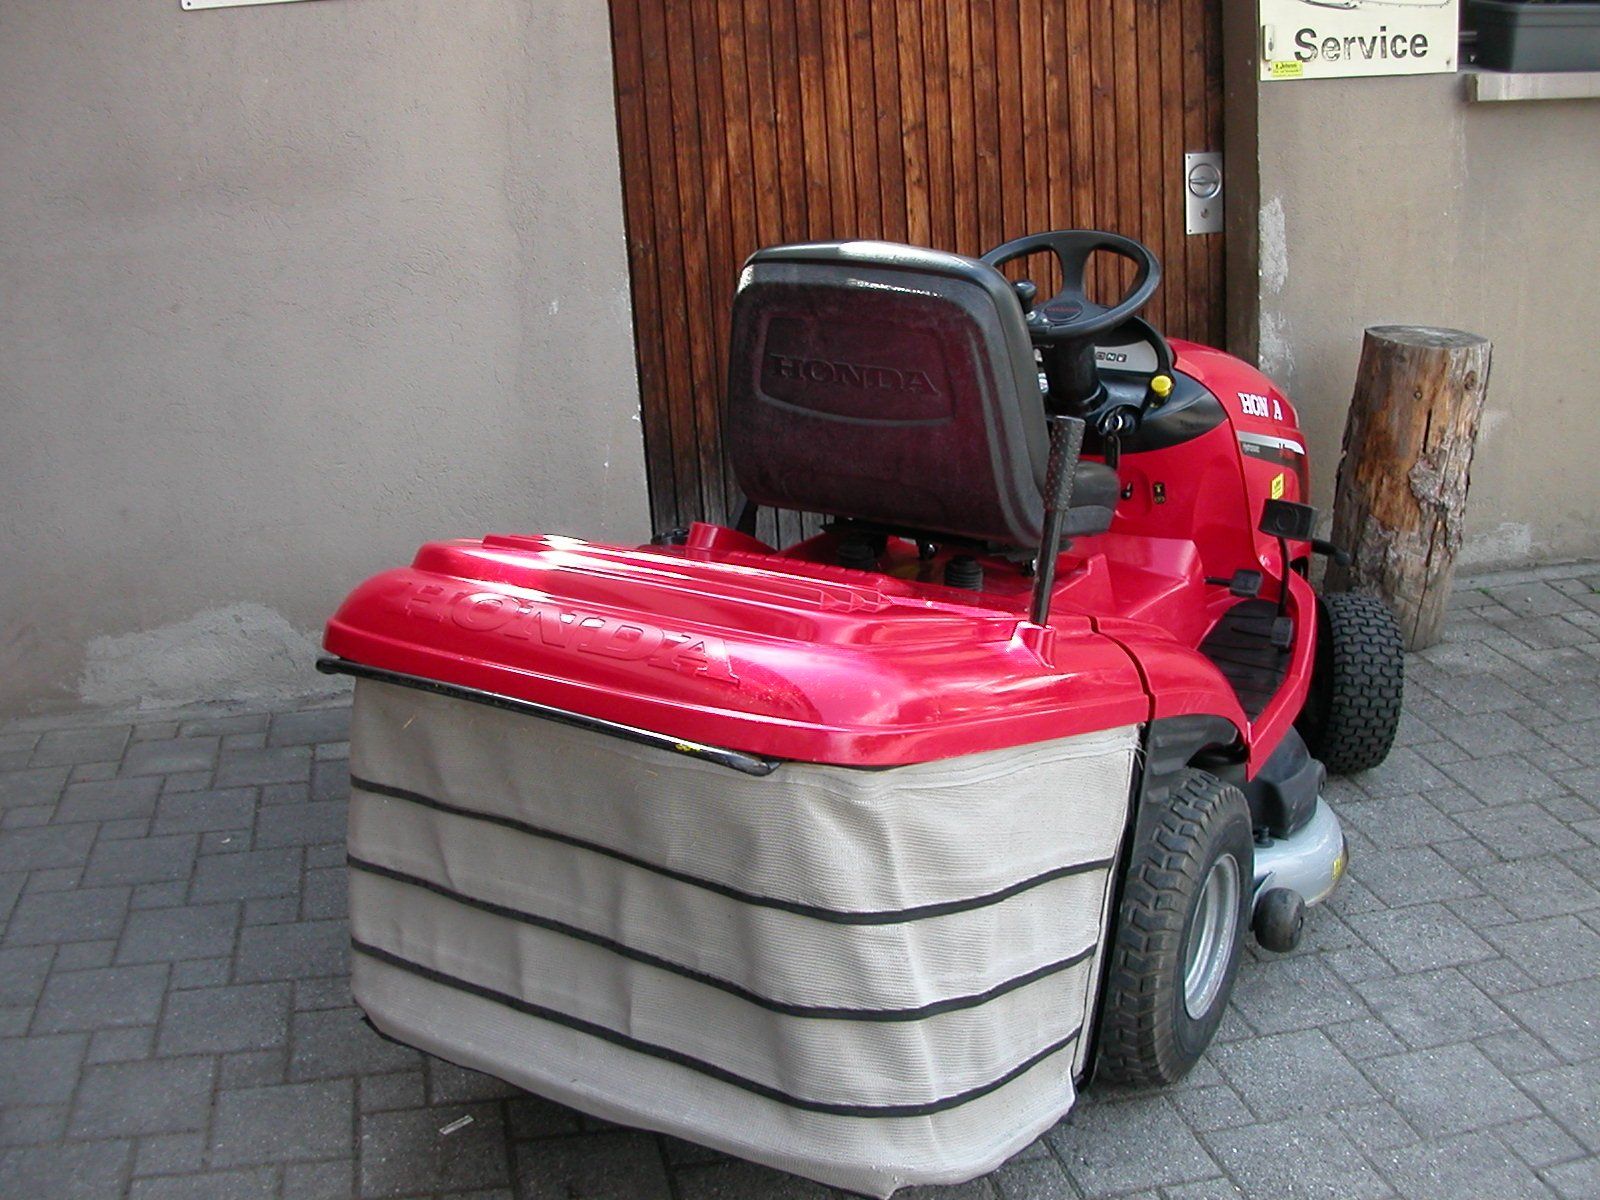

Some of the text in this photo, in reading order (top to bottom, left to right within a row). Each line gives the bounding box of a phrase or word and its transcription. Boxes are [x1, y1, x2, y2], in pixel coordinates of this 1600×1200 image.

[1294, 26, 1429, 63] Service
[769, 352, 942, 398] HONDA
[404, 581, 742, 690] HONDA
